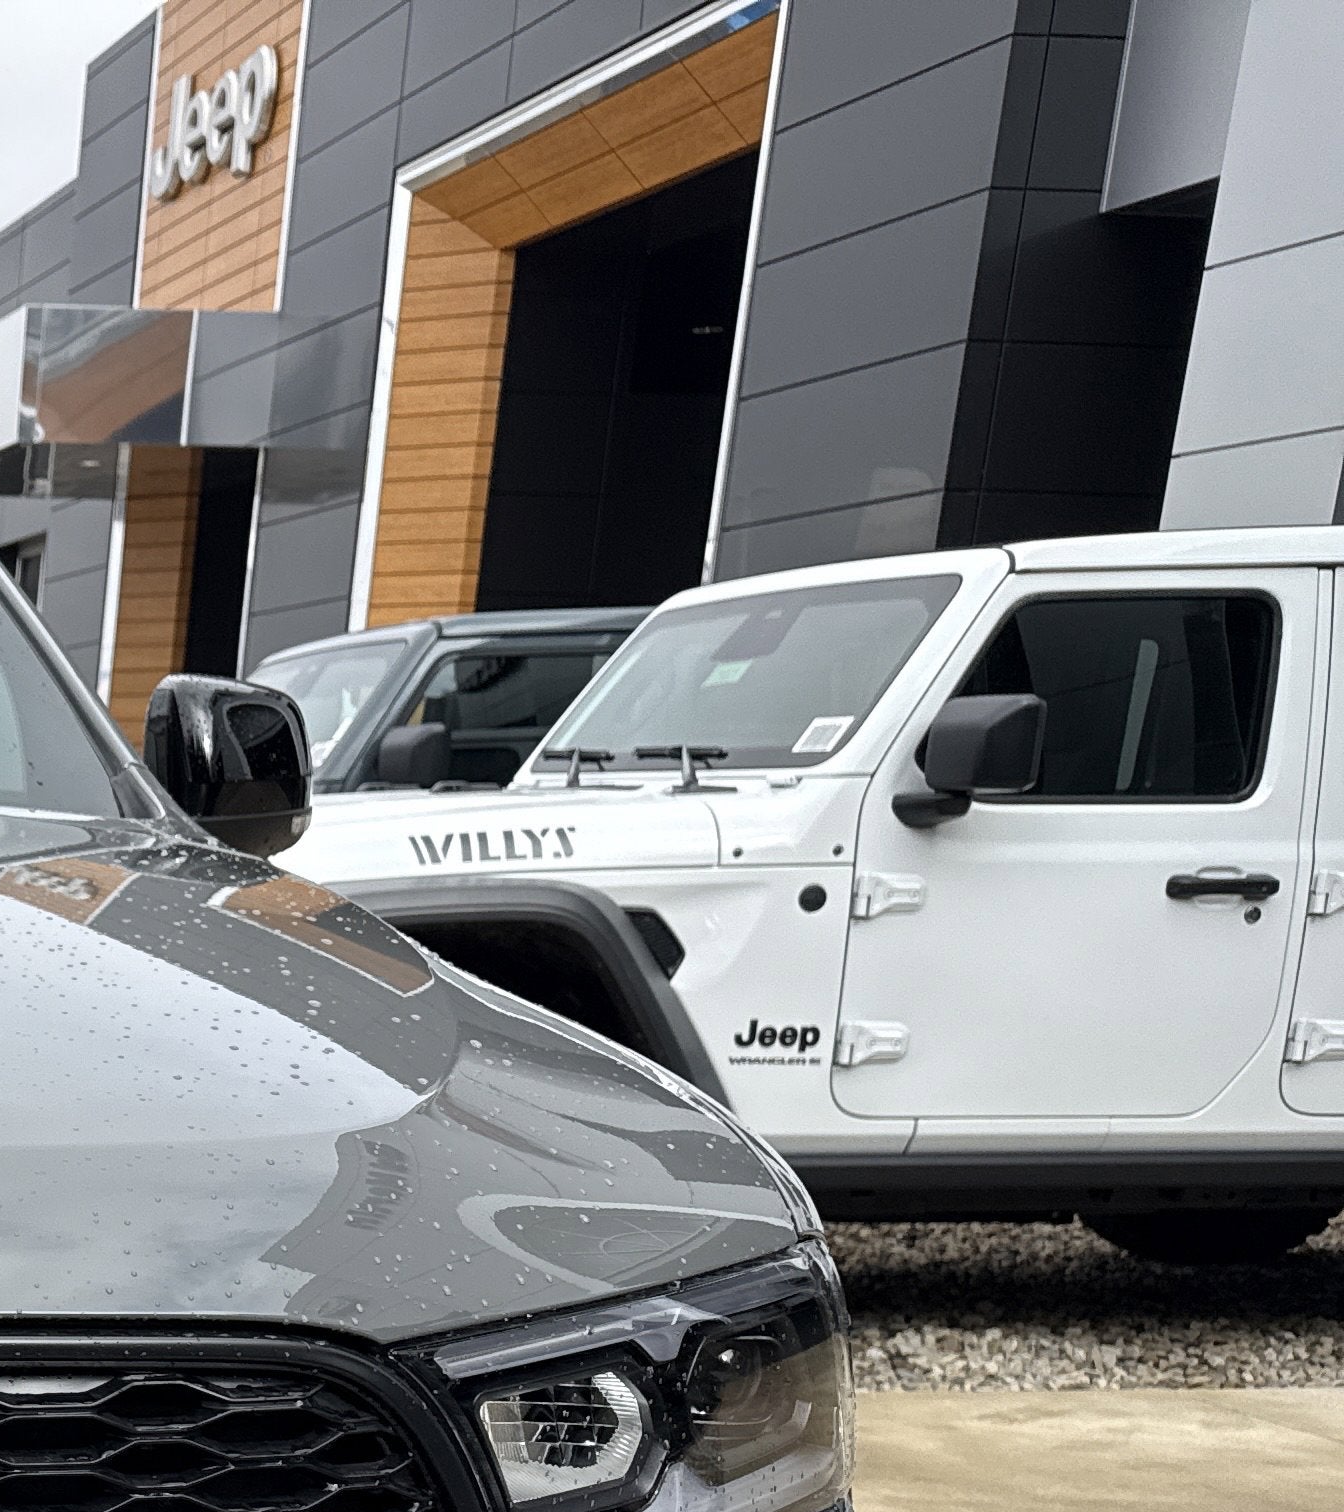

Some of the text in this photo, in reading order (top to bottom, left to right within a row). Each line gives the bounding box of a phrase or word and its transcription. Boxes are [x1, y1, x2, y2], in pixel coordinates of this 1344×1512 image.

[149, 43, 278, 201] Jeep
[408, 826, 576, 865] WILLYS
[734, 1018, 821, 1053] Jeep
